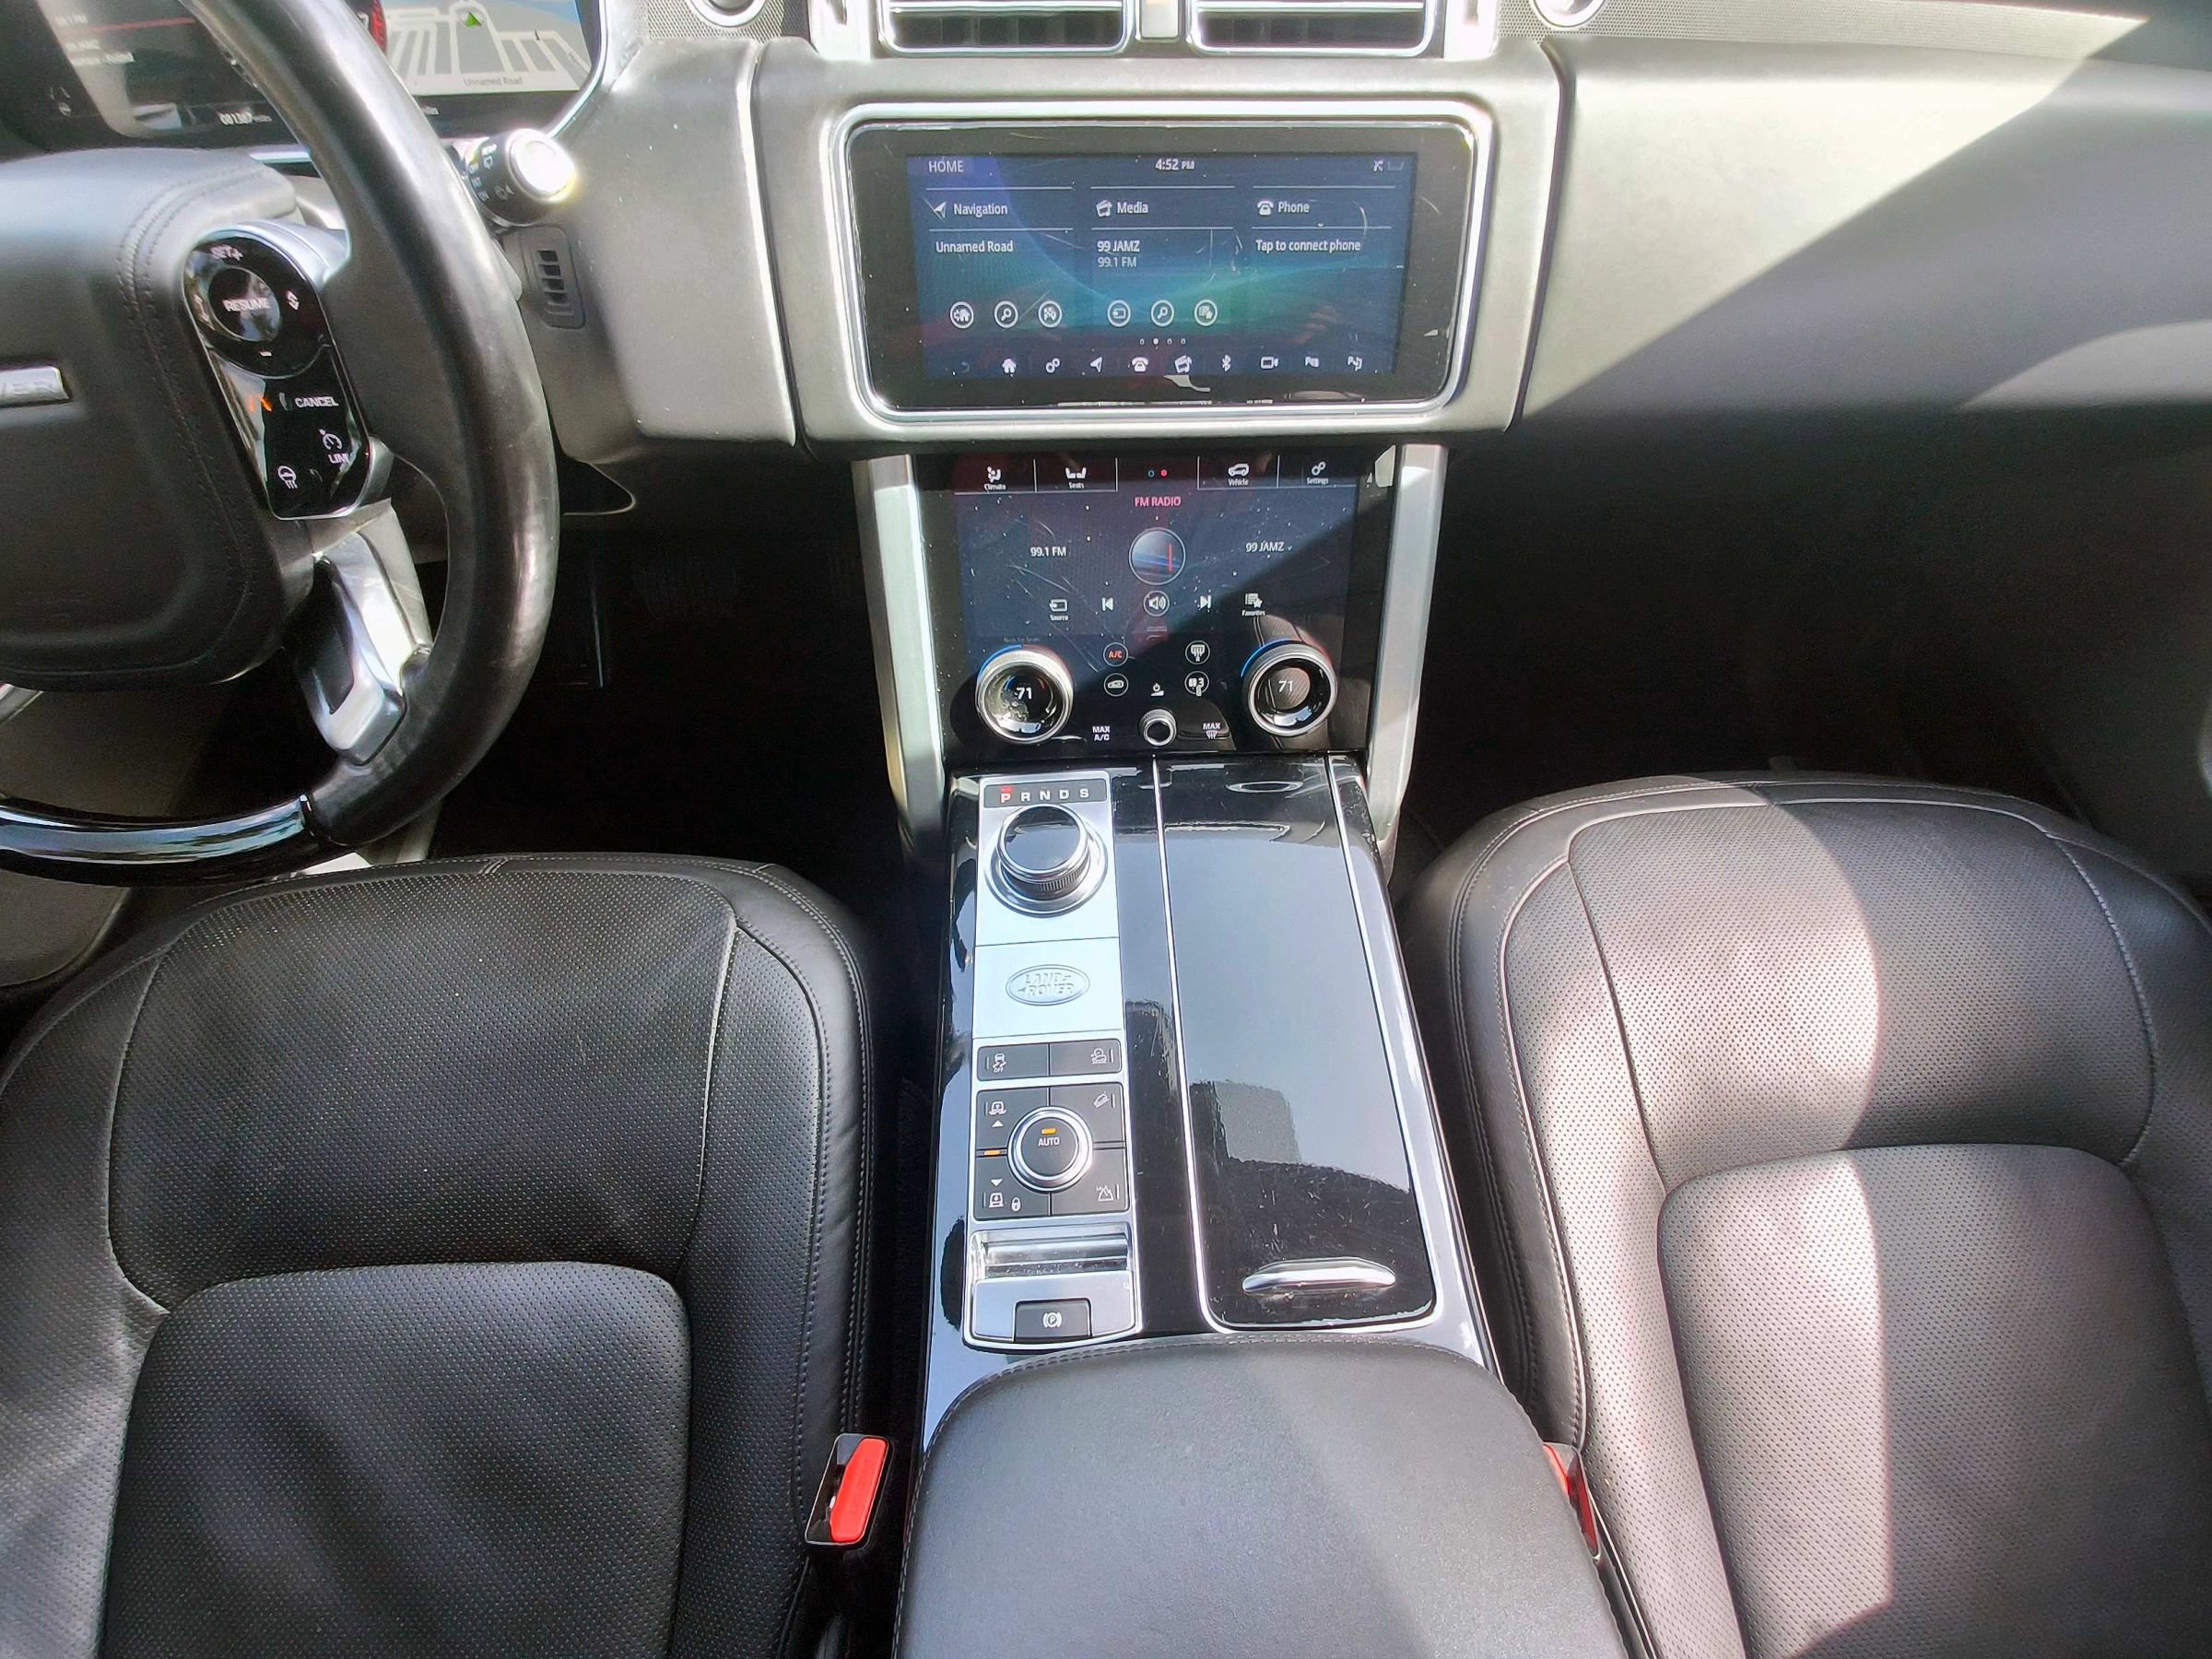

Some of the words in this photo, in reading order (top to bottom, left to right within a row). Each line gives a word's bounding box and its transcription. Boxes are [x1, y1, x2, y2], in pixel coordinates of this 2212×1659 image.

[464, 76, 501, 86] Unnamed
[503, 76, 523, 85] Road
[928, 160, 964, 173] HOME
[1155, 159, 1179, 171] 4:52
[1181, 160, 1195, 170] PM
[953, 203, 1008, 218] Navigation
[1117, 202, 1148, 214] Media
[1277, 201, 1310, 214] Phone
[935, 241, 985, 253] Unnamed
[987, 240, 1014, 252] Road
[1097, 240, 1110, 252] 99
[1112, 240, 1140, 253] JAMZ
[1255, 239, 1274, 253] Tap
[1276, 240, 1287, 251] to
[1288, 240, 1328, 252] connect
[1329, 240, 1360, 253] phone
[1097, 256, 1119, 267] 99.1
[1122, 256, 1136, 267] FM
[222, 298, 272, 312] RESUME
[294, 396, 339, 407] CANCEL
[1135, 497, 1149, 507] FM
[1151, 496, 1182, 506] RADIO
[1030, 547, 1049, 557] 99.1
[1052, 547, 1066, 557] FM
[1245, 542, 1257, 552] 99
[1259, 541, 1284, 552] JAMZ
[1108, 650, 1123, 659] A/C
[1277, 680, 1293, 693] 71
[1016, 687, 1032, 700] 71
[1092, 725, 1110, 734] MAX
[1203, 722, 1221, 730] MAX
[1094, 734, 1110, 742] A/C
[1000, 793, 1011, 803] P
[1021, 792, 1031, 802] R
[1040, 791, 1051, 800] N
[1060, 790, 1069, 799] D
[1079, 788, 1089, 798] S
[1038, 1136, 1060, 1146] AUTO
